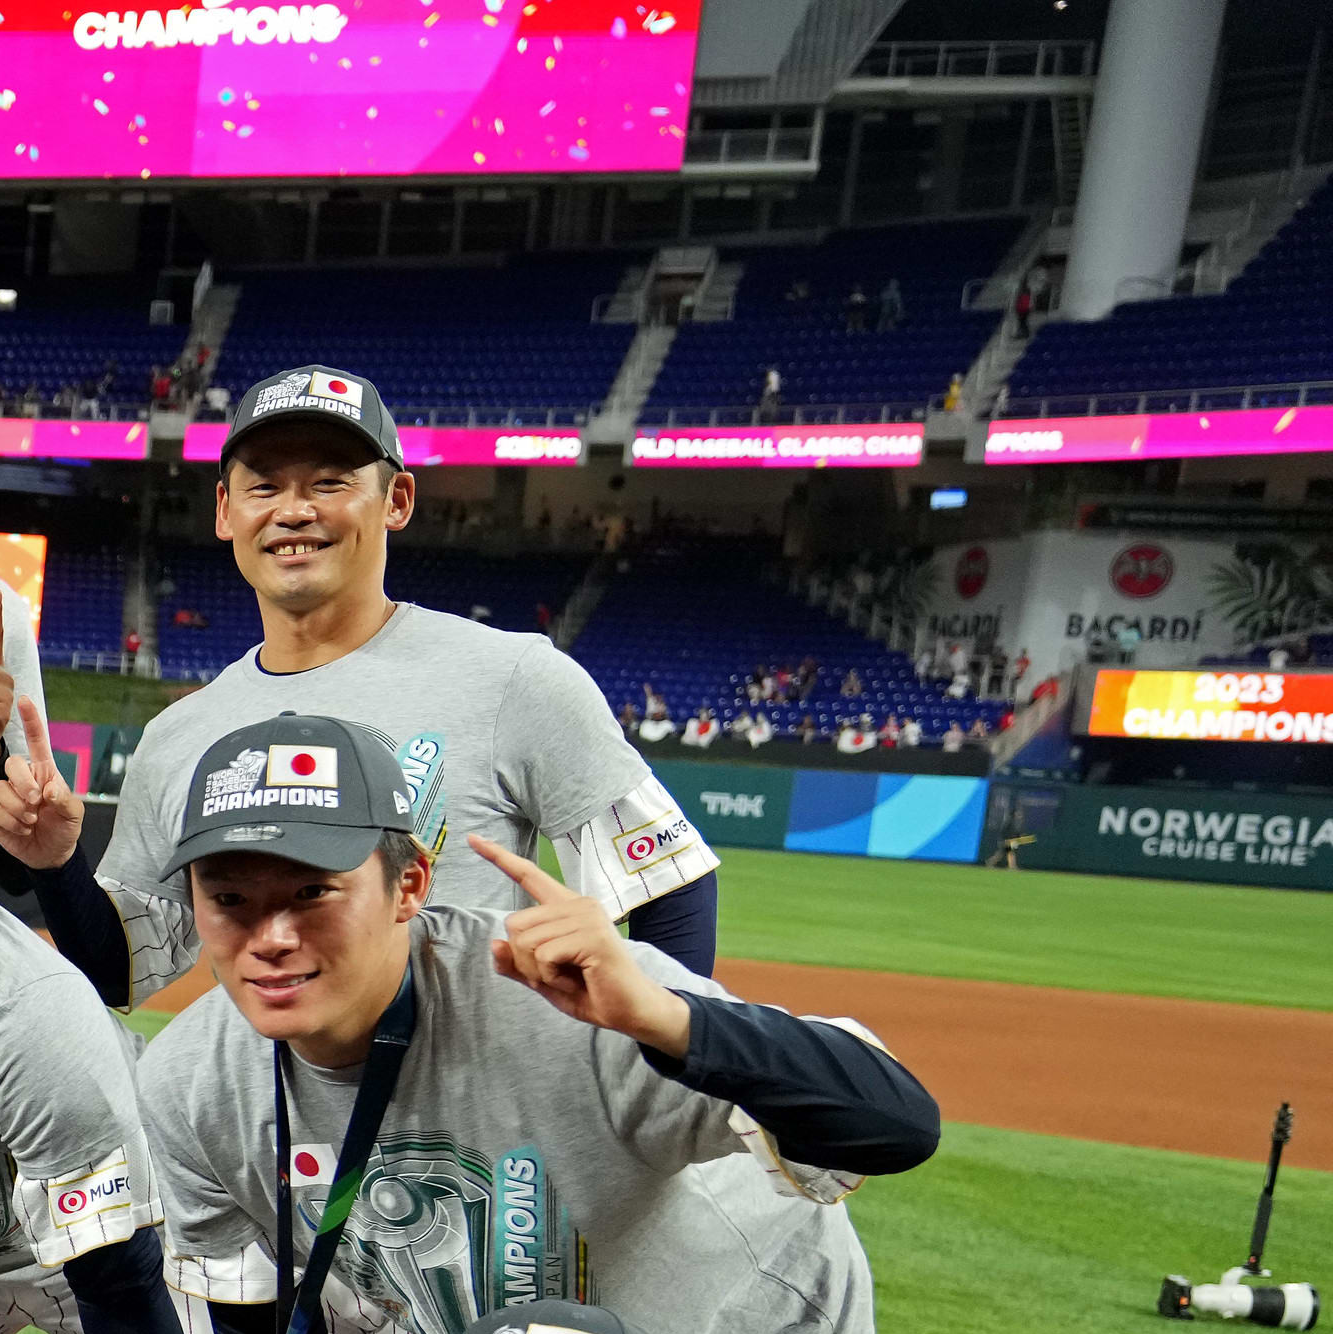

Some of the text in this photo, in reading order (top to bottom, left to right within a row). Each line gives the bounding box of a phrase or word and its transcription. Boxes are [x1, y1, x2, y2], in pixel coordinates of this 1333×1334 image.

[73, 3, 345, 50] CHAMPIONS
[253, 396, 361, 420] CHAMPIONS
[676, 437, 778, 459] BASEBALL
[778, 436, 863, 457] CLASSIC
[1194, 674, 1285, 703] 2023
[212, 773, 258, 787] BASEBALL
[213, 768, 243, 780] WORLD
[202, 788, 338, 816] CHAMPIONS
[211, 782, 250, 795] CLASSIC
[700, 791, 765, 819] THK
[1141, 835, 1309, 867] CRUISE LINE
[503, 1156, 537, 1308] AMPIONS
